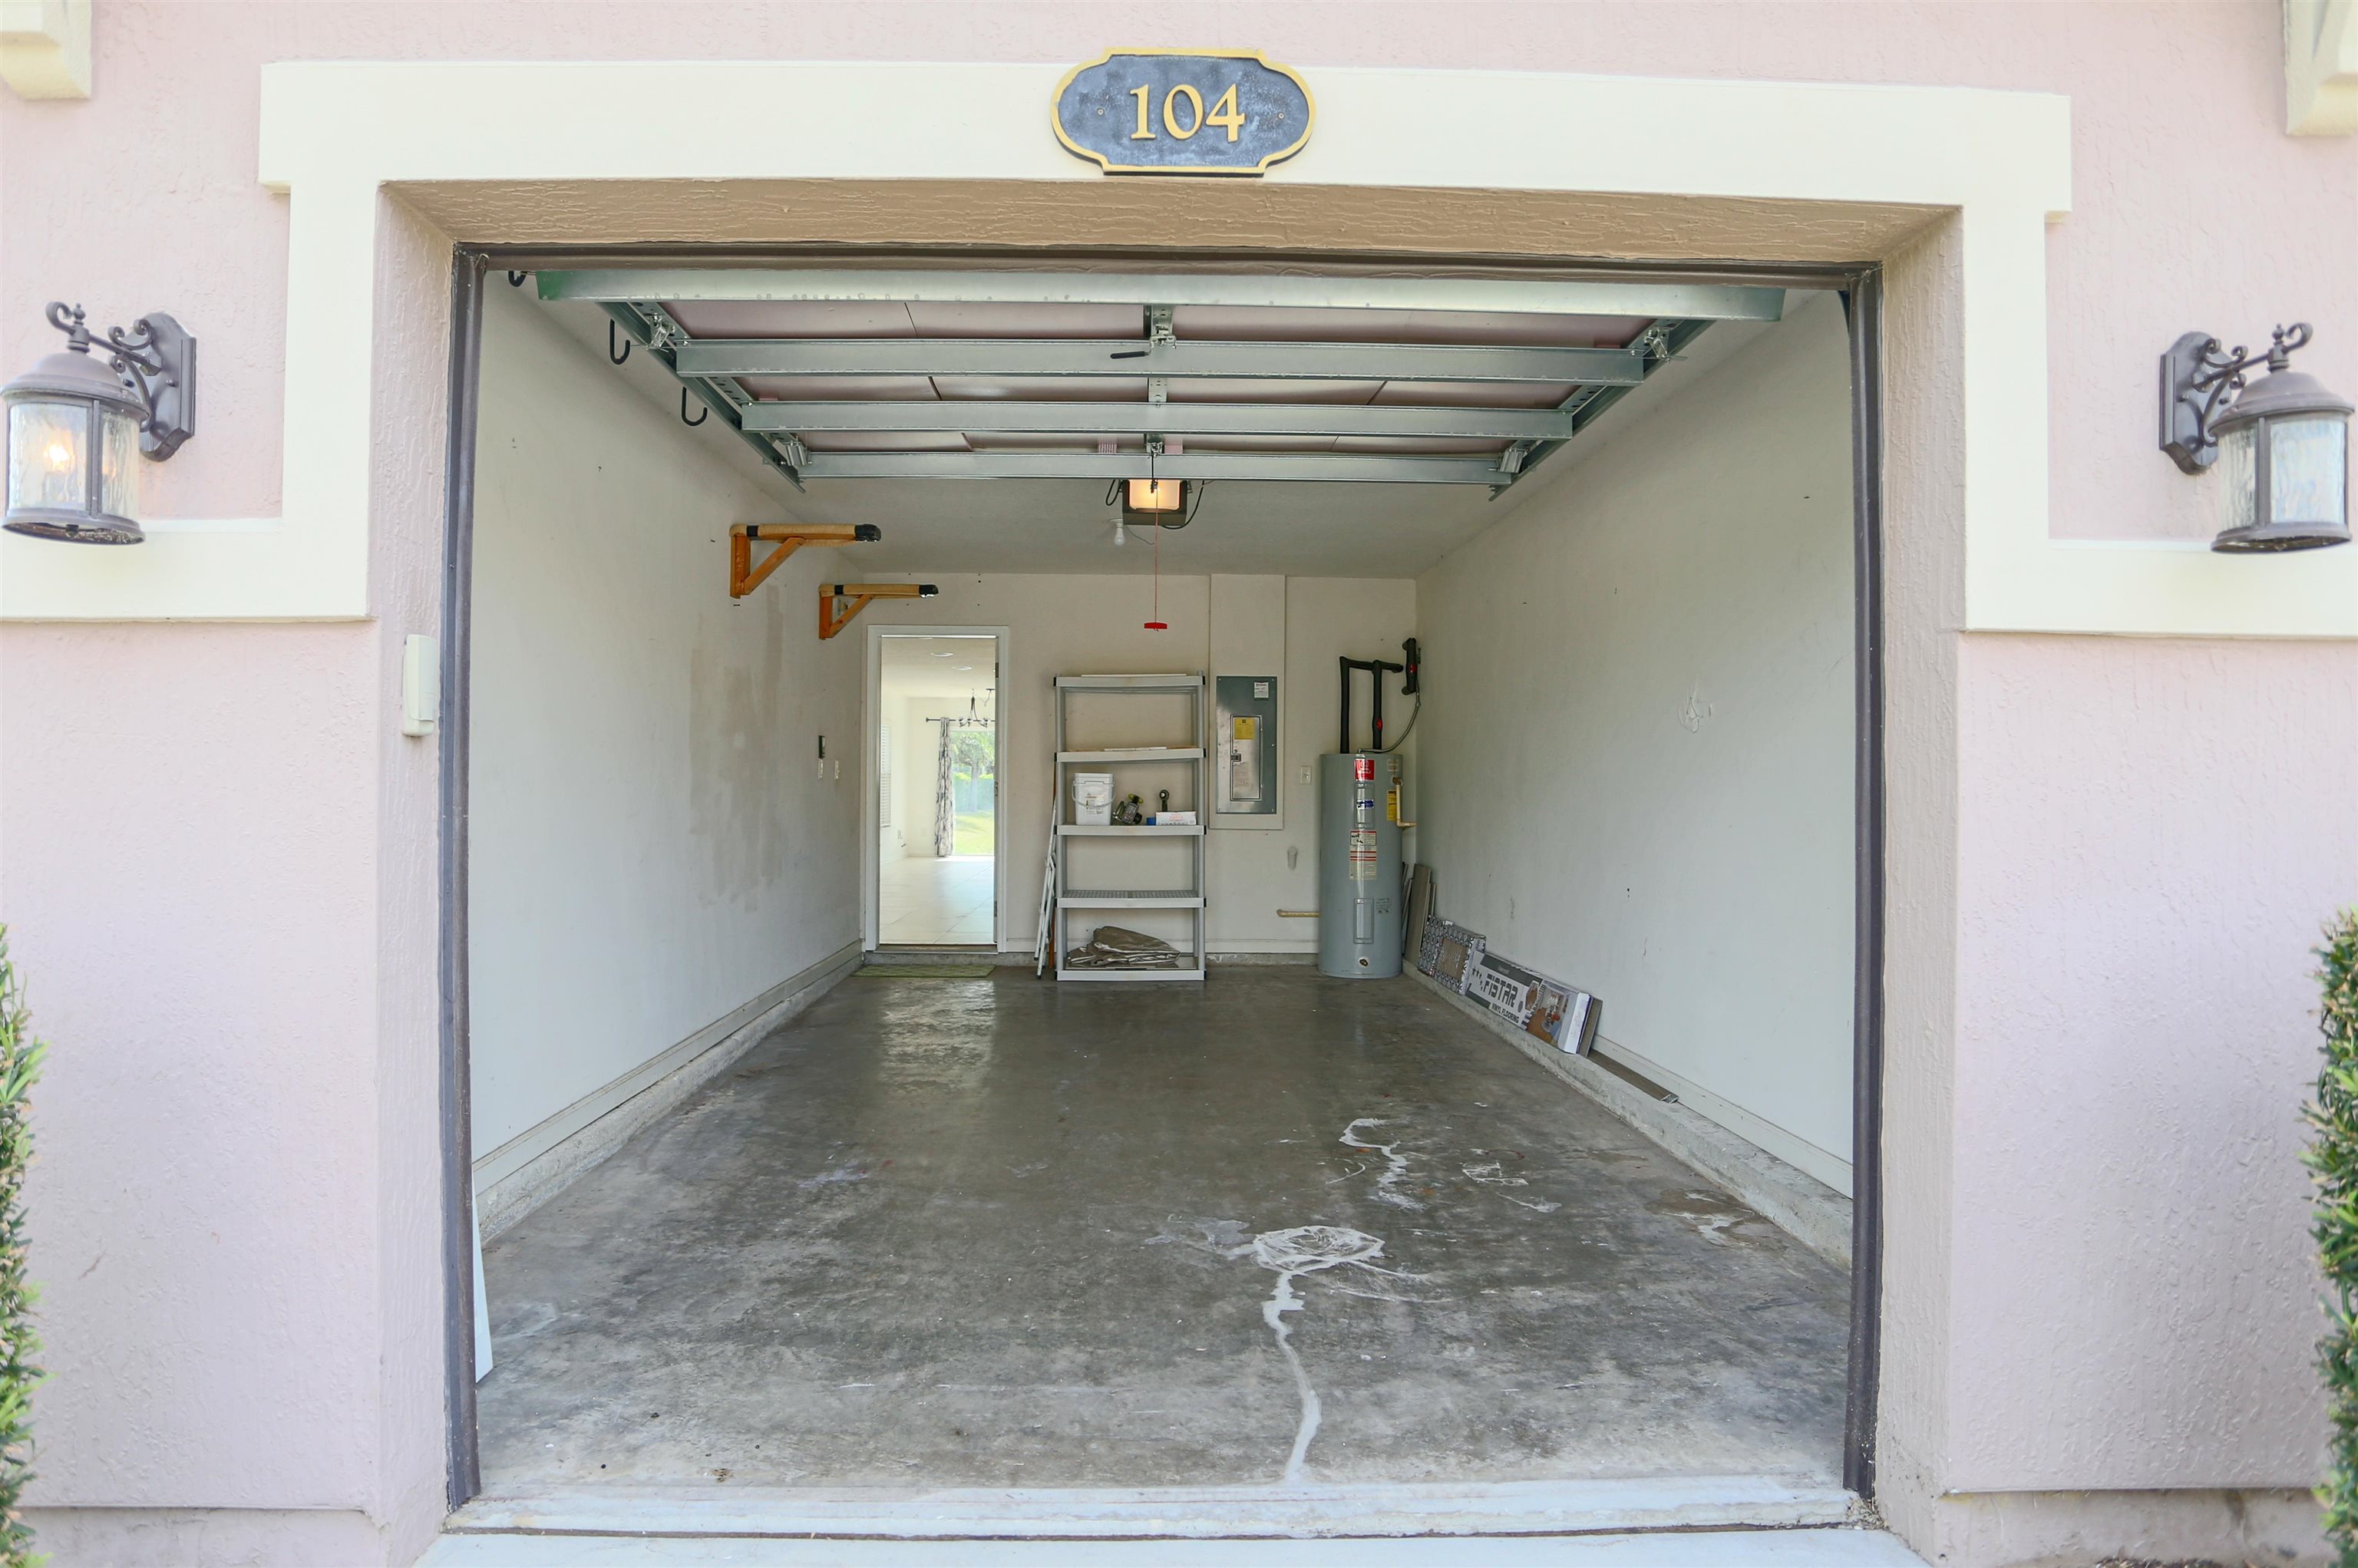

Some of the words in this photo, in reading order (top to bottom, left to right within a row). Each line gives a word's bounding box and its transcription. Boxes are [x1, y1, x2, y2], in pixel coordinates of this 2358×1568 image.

[1129, 83, 1246, 143] 104
[1491, 1002, 1501, 1014] VINYL
[1501, 1008, 1520, 1023] FLOORING
